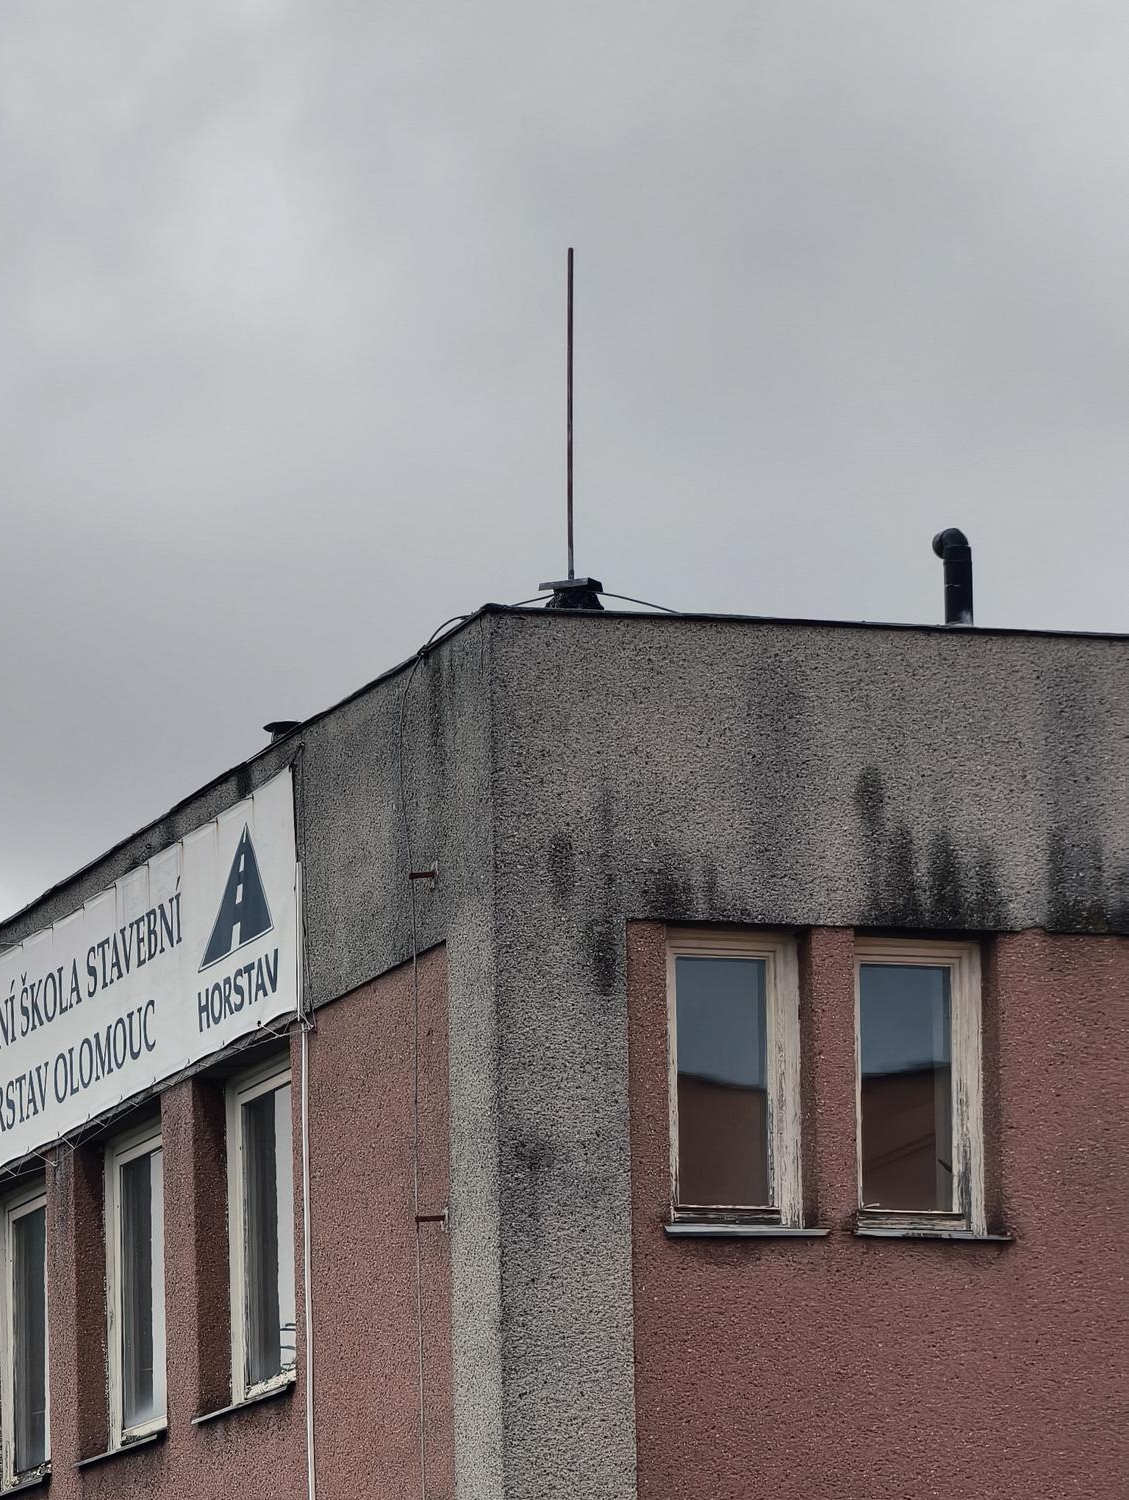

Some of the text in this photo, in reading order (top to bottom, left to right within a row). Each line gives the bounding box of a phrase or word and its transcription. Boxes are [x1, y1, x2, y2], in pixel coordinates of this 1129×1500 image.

[19, 957, 82, 1038] ŠKOLA
[86, 876, 183, 998] STAVEBNÍ
[197, 948, 279, 1032] HORSTAV
[53, 1000, 158, 1104] OLOMOUC
